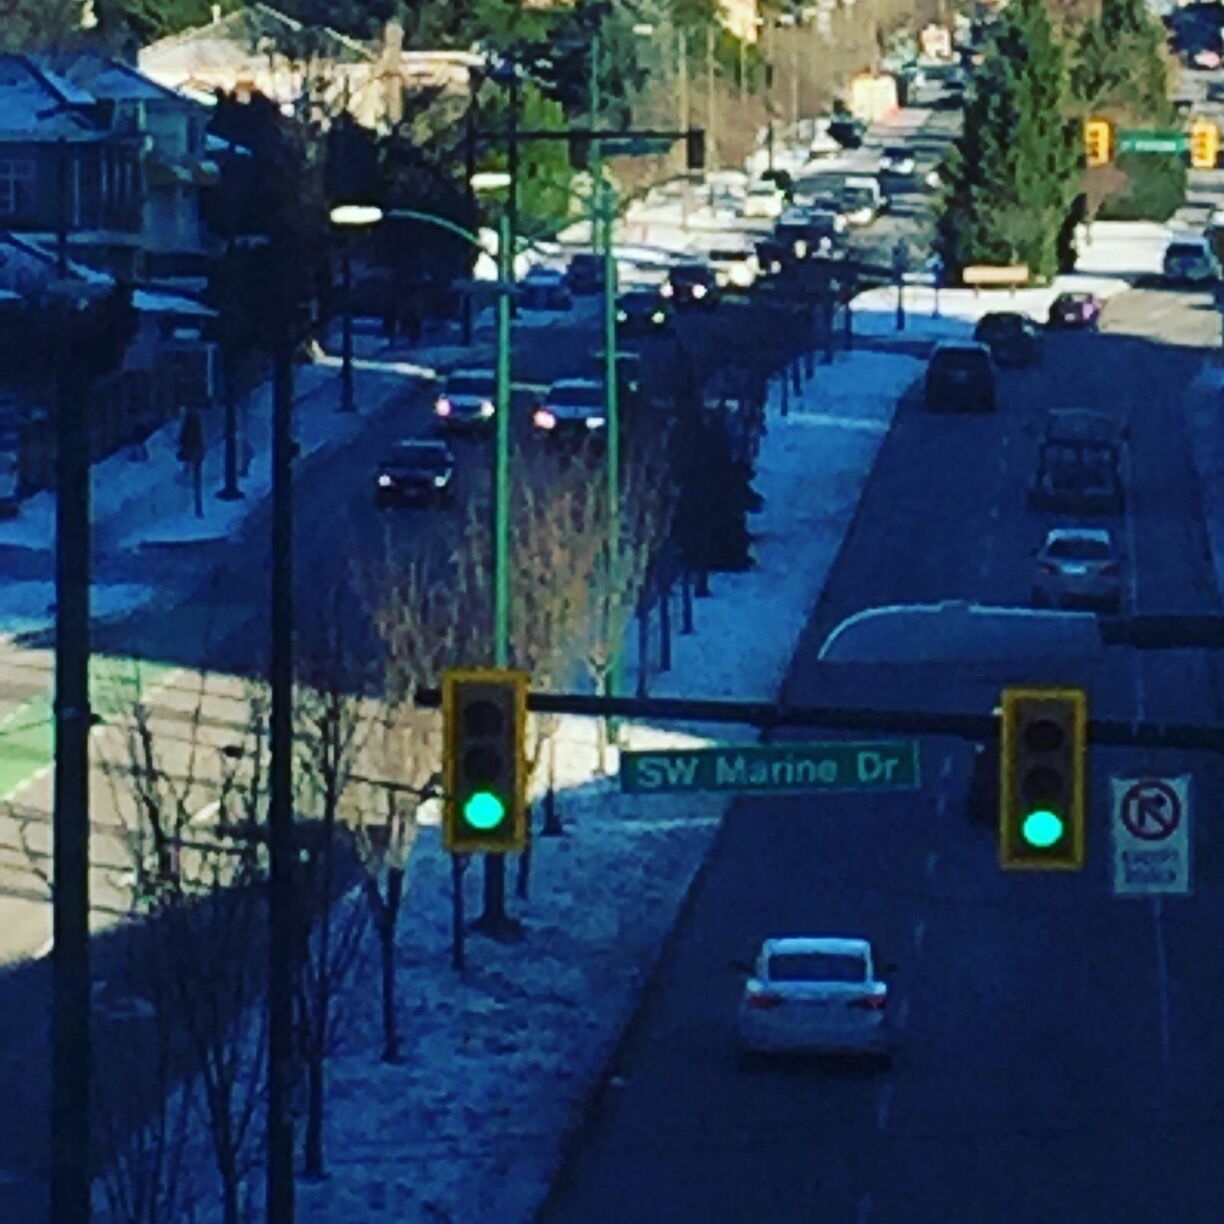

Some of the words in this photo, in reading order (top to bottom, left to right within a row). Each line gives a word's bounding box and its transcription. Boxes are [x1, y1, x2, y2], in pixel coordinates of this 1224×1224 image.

[637, 755, 699, 788] SW
[715, 752, 838, 786] Marine
[857, 751, 899, 782] Dr
